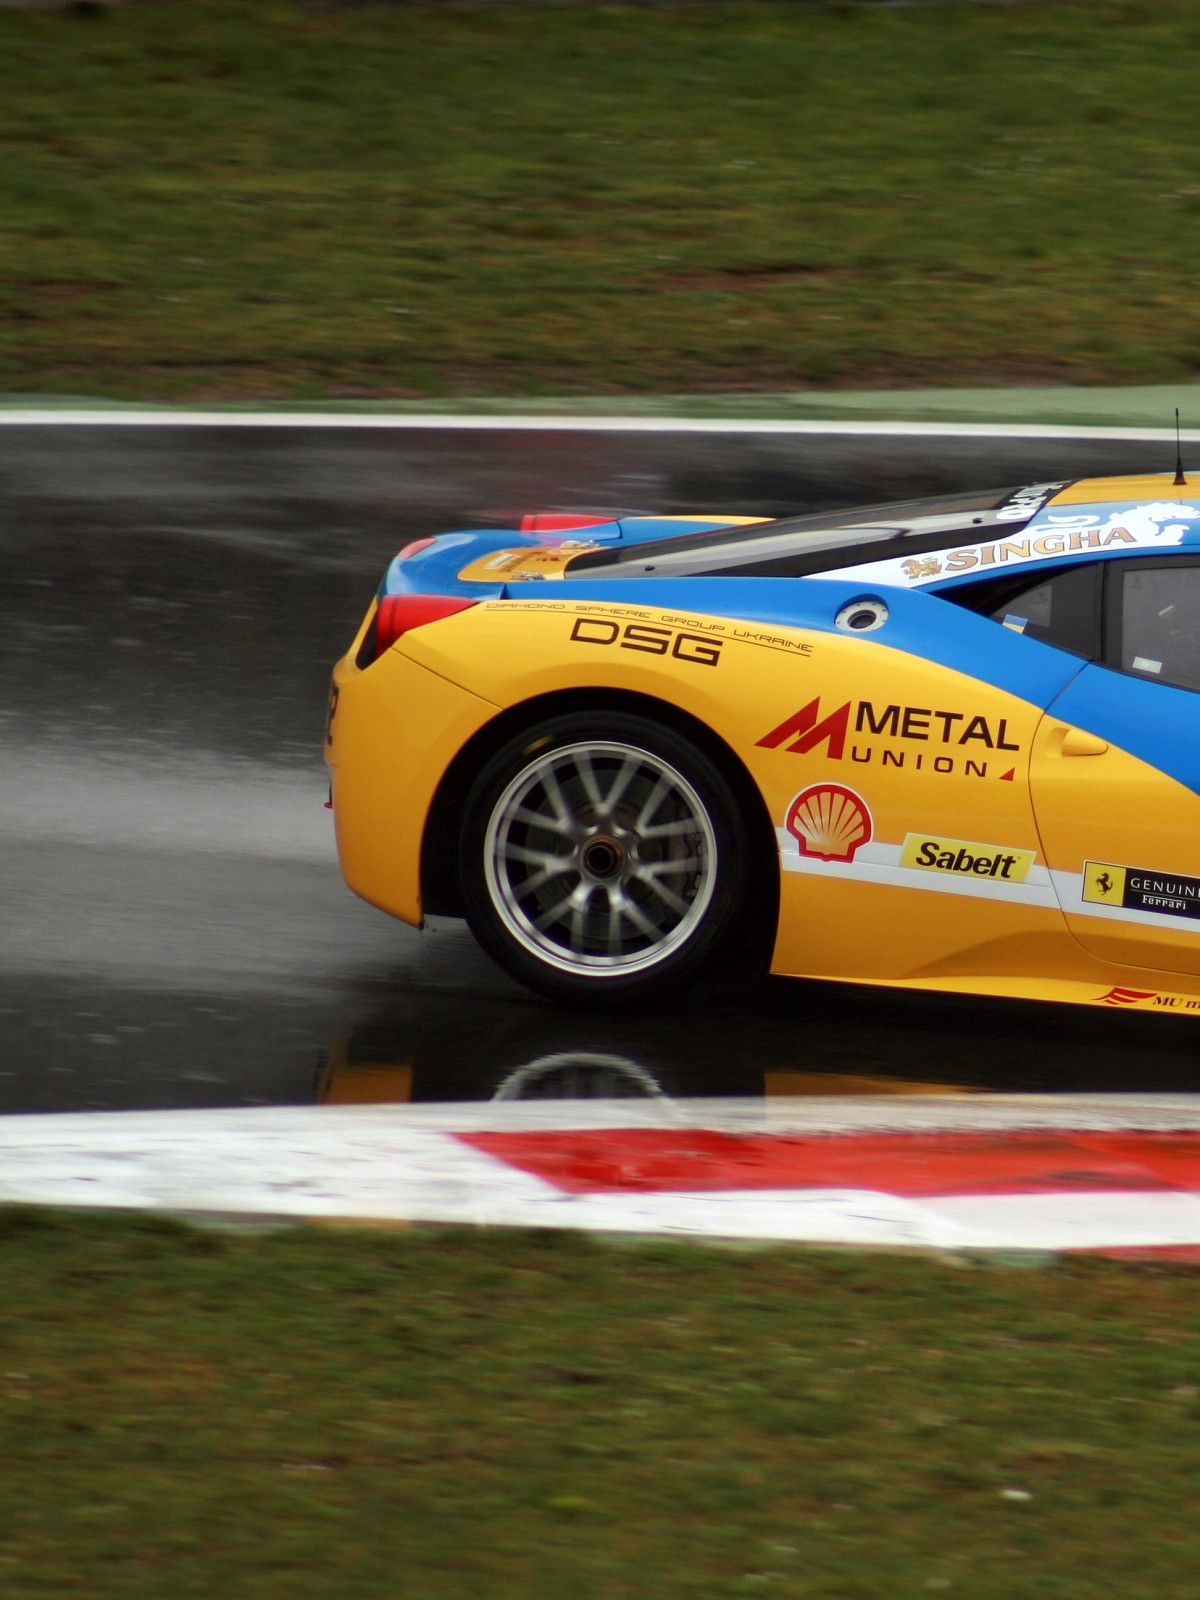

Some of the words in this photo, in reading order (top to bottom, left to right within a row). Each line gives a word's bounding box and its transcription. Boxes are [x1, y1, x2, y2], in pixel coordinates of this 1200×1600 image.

[944, 526, 1138, 572] SINGHA
[485, 601, 566, 610] DIAMOND
[575, 604, 652, 619] SPHERE
[661, 614, 726, 632] GROUP
[733, 628, 814, 653] UKRAINE
[570, 617, 724, 667] DSG
[855, 700, 1021, 752] METAL
[851, 746, 988, 778] UNION
[915, 841, 1018, 879] Sabelt
[1141, 894, 1187, 911] Ferrari
[1152, 995, 1184, 1009] MU
